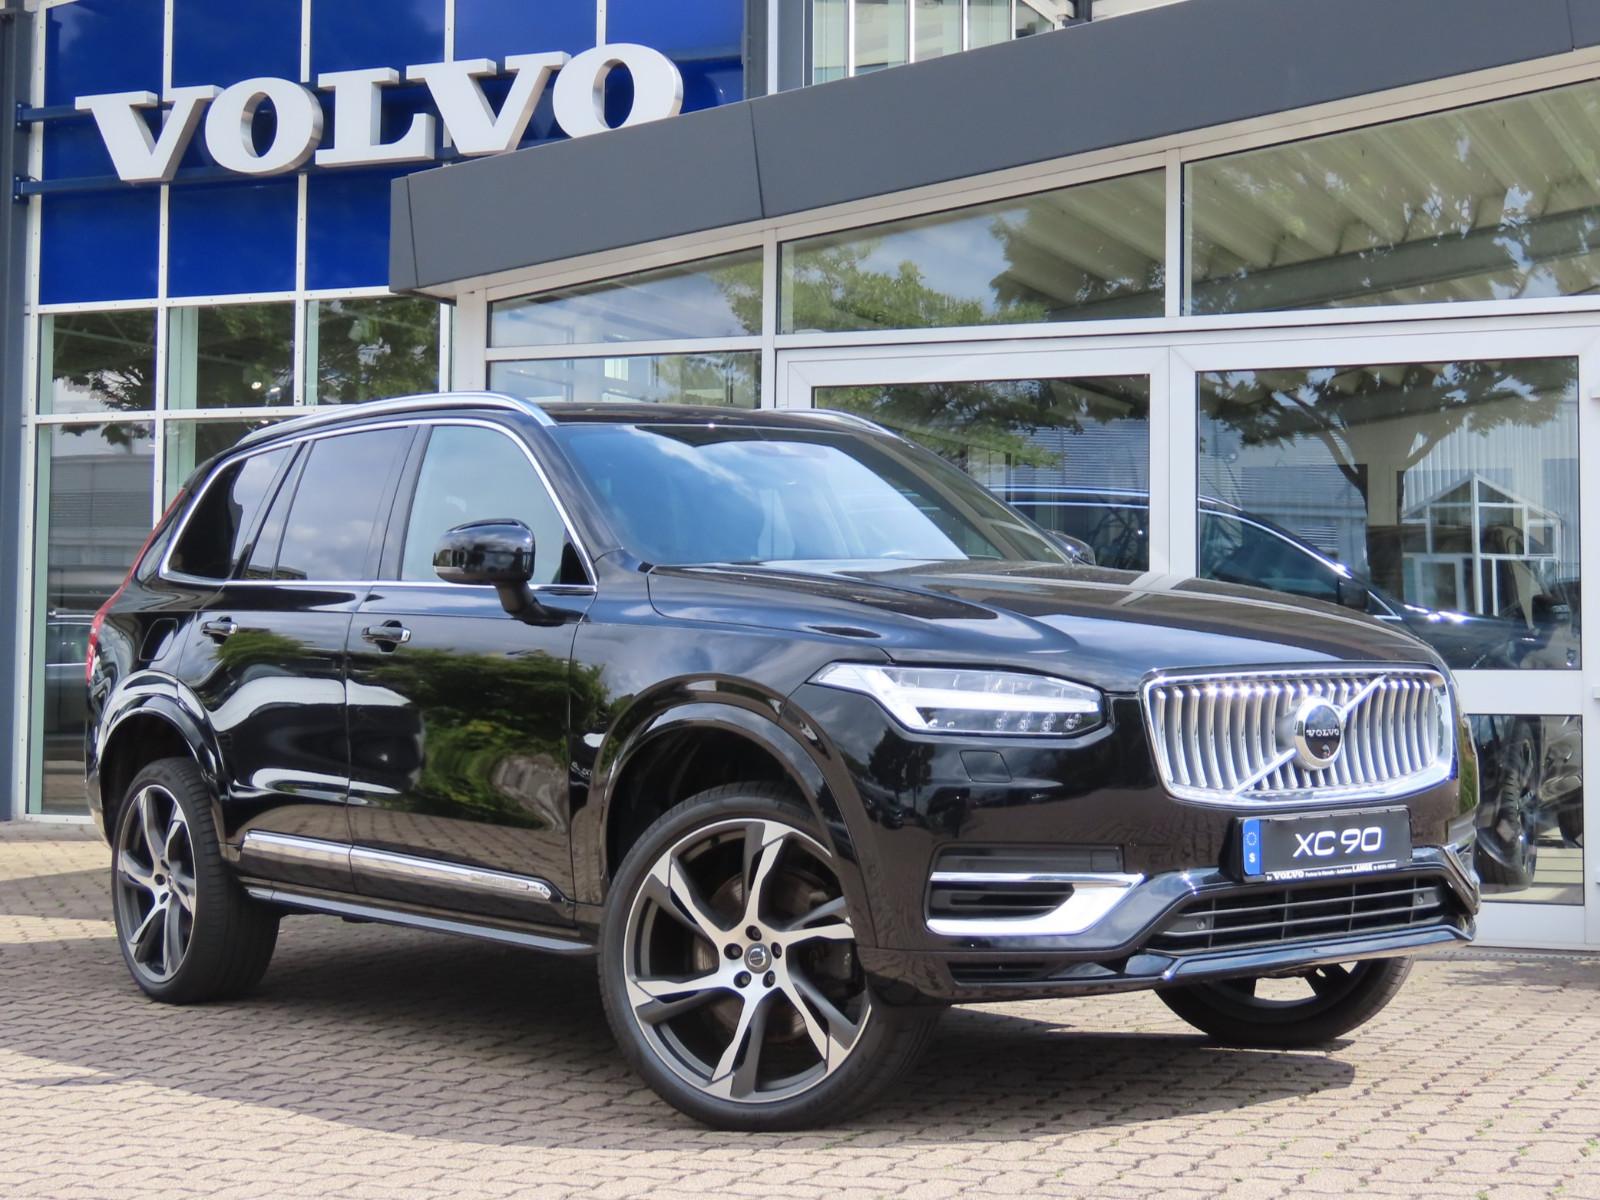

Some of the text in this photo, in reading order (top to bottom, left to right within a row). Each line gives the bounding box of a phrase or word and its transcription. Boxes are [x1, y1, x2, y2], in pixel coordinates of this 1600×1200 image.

[75, 43, 683, 184] VOLVO
[1306, 728, 1340, 738] VOLVO
[1273, 869, 1304, 880] VOLVO
